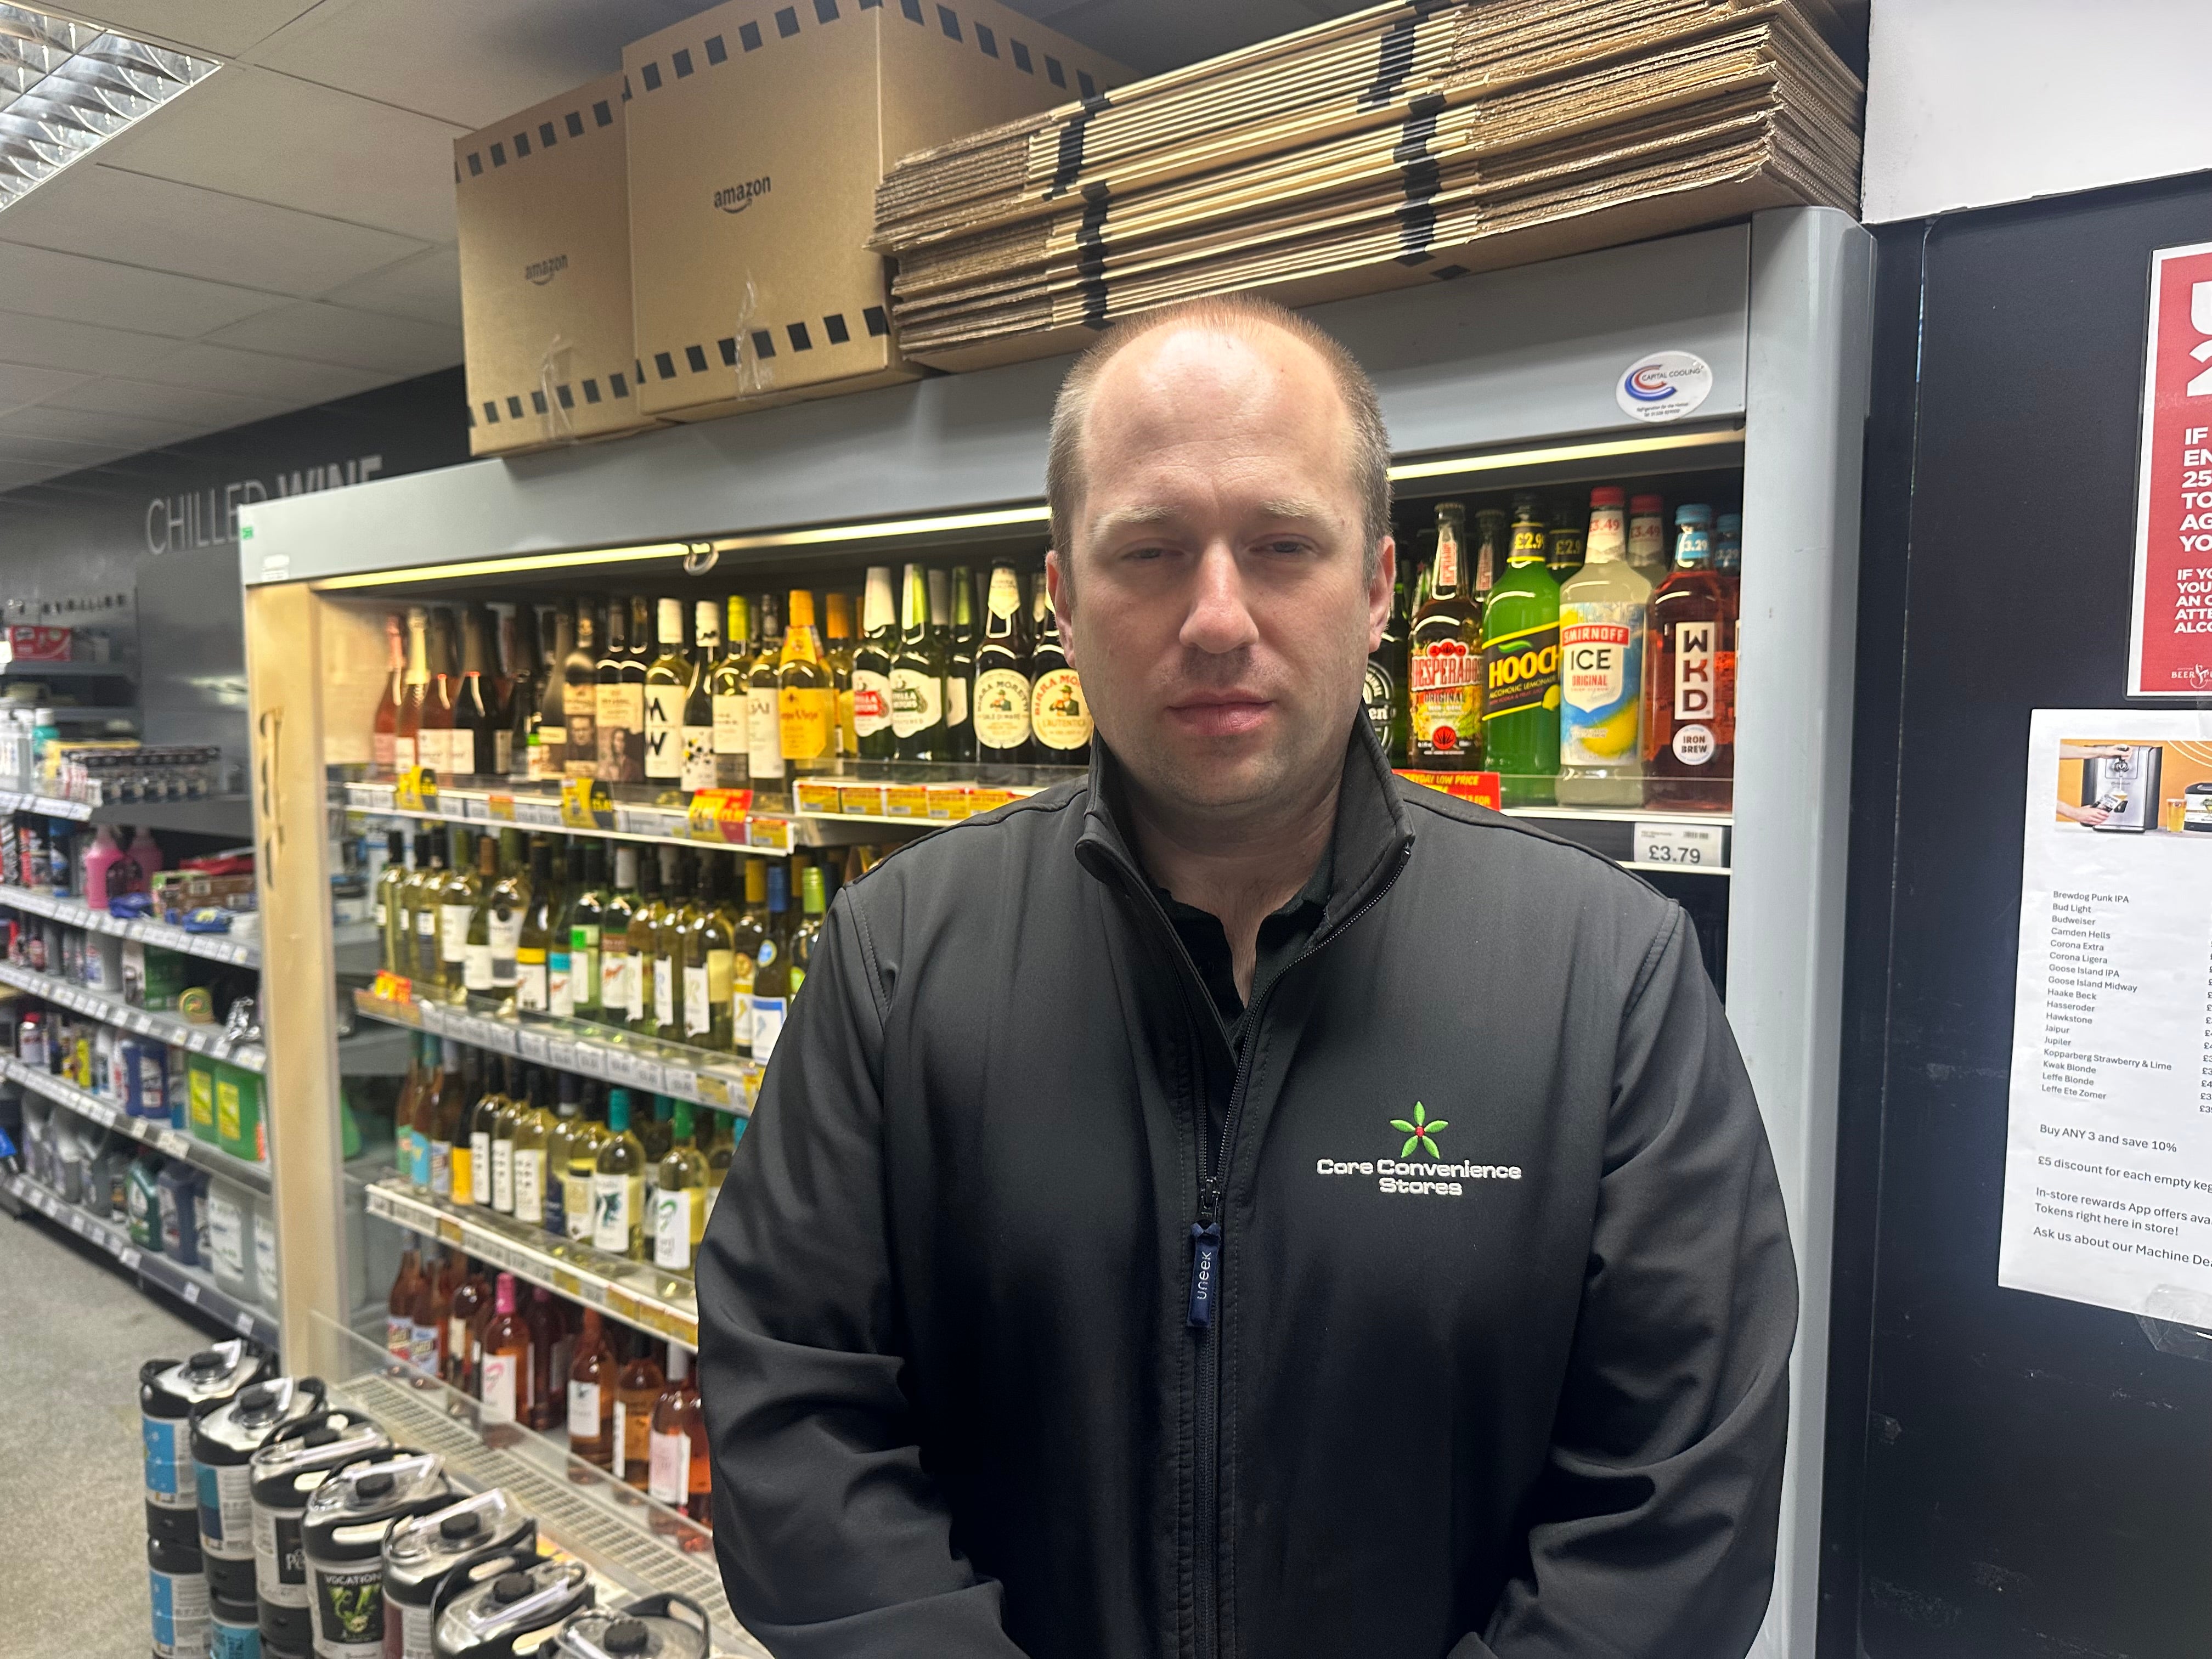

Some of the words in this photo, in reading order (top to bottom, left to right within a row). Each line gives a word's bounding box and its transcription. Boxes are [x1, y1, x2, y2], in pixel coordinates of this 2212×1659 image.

[714, 176, 771, 208] amazon
[525, 254, 569, 280] amazon
[1641, 373, 1667, 381] CAPITAL
[1669, 368, 1701, 377] COOLING
[2185, 426, 2208, 445] IF
[2182, 469, 2212, 488] 25
[2181, 491, 2212, 509] TO
[2179, 512, 2212, 531] AG
[1682, 539, 1708, 551] 3.29
[2179, 534, 2212, 552] YO
[2177, 569, 2193, 580] IF
[2177, 581, 2212, 594] YOU
[2175, 595, 2201, 607] AN
[1564, 628, 1624, 643] SMIRNOFF
[1570, 649, 1611, 670] ICE
[1412, 658, 1481, 687] DESPERADOS
[1489, 645, 1562, 690] HOOCH
[1683, 630, 1709, 712] WKD
[1571, 674, 1608, 687] ORIGINAL
[2171, 671, 2195, 679] BEER
[1424, 692, 1465, 703] ORIGINAL
[1489, 684, 1522, 699] ALCOHOLIC
[1683, 735, 1705, 744] IRON
[1681, 745, 1707, 754] BREW
[1436, 774, 1453, 785] LOW
[1454, 775, 1480, 785] PRICE
[1649, 845, 1701, 864] £3.79
[2053, 890, 2090, 901] Brewdog
[2091, 893, 2113, 902] Punk
[2115, 895, 2129, 903] IPA
[2070, 904, 2091, 913] Light
[2052, 915, 2096, 926] Budweiser
[2051, 927, 2086, 937] Camden
[2089, 930, 2111, 939] Hells
[2050, 939, 2081, 949] Corona
[2083, 943, 2104, 951] Extra
[2050, 952, 2080, 961] Corona
[2082, 955, 2108, 964] Ligera
[2049, 964, 2076, 973] Goose
[2078, 967, 2103, 976] Island
[2106, 969, 2120, 978] IPA
[2048, 976, 2075, 986] Goose
[2076, 979, 2102, 988] Island
[2104, 981, 2138, 993] Midway
[2047, 988, 2074, 997] Haake
[2076, 991, 2097, 1000] Beck
[2047, 1000, 2095, 1012] Hasseroder
[2046, 1012, 2092, 1024] Hawkstone
[2045, 1024, 2070, 1034] Jaipur
[2044, 1036, 2072, 1046] Jupiler
[2044, 1048, 2092, 1063] Kopparberg
[2094, 1054, 2140, 1068] Strawberry
[2150, 1061, 2172, 1070] Lime
[2043, 1060, 2064, 1070] Kwak
[2067, 1063, 2096, 1074] Blonde
[2042, 1072, 2063, 1081] Leffe
[2064, 1075, 2094, 1086] Blonde
[2201, 1080, 2212, 1088] £4
[2041, 1084, 2062, 1093] Leffe
[2064, 1087, 2078, 1096] Ete
[2079, 1090, 2107, 1099] Zomer
[2040, 1124, 2060, 1137] Buy
[2062, 1127, 2086, 1139] ANY
[2088, 1131, 2095, 1141] 3
[2098, 1134, 2119, 1144] and
[2122, 1138, 2148, 1148] save
[2151, 1141, 2177, 1153] 10%
[1317, 1159, 1374, 1175] Core
[1376, 1159, 1522, 1180] Convenience
[2038, 1155, 2052, 1166] £5
[2054, 1159, 2103, 1175] discount
[2105, 1166, 2121, 1177] for
[2123, 1170, 2151, 1182] each
[2154, 1175, 2191, 1189] empty
[2193, 1180, 2212, 1193] keg
[1379, 1177, 1463, 1196] Stores
[2036, 1187, 2078, 1203] In-store
[2081, 1195, 2126, 1211] rewards
[2128, 1203, 2151, 1216] App
[2154, 1208, 2187, 1221] offers
[2190, 1214, 2212, 1225] ava
[2035, 1202, 2073, 1218] Tokens
[2076, 1211, 2101, 1223] right
[2104, 1214, 2129, 1227] here
[2131, 1219, 2142, 1229] in
[2145, 1222, 2179, 1236] store!
[2033, 1226, 2055, 1239] Ask
[2057, 1232, 2071, 1242] us
[2074, 1234, 2109, 1249] about
[2112, 1242, 2133, 1252] our
[2136, 1244, 2189, 1262] Machine
[1197, 1251, 1211, 1300] uneek
